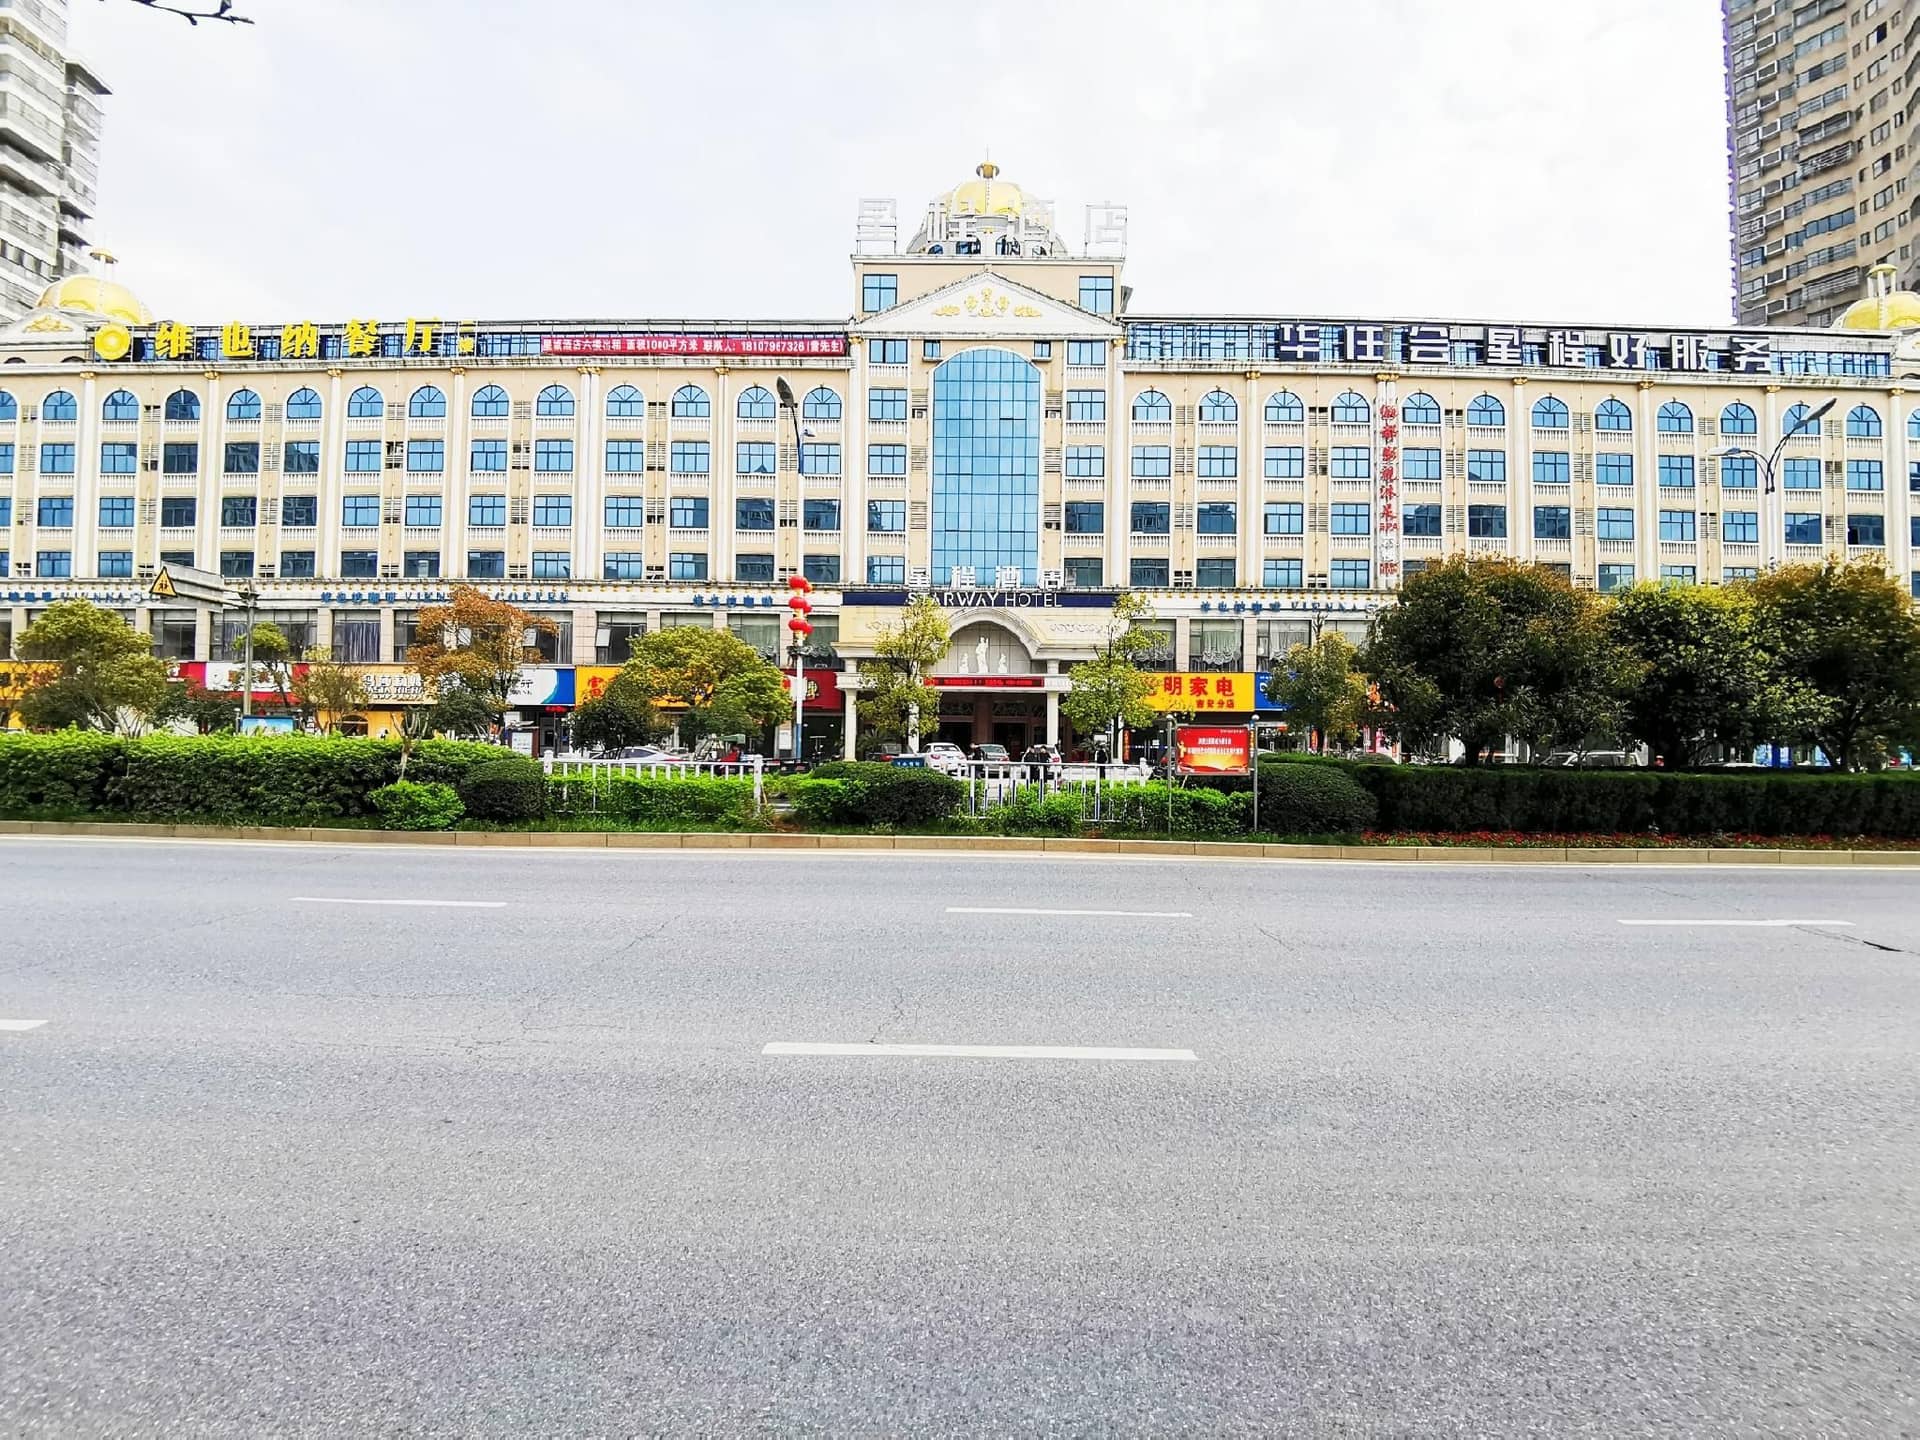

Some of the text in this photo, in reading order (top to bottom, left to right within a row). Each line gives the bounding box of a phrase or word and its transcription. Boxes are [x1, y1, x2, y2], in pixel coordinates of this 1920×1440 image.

[154, 317, 440, 359] 维也纳餐厅
[908, 566, 1064, 589] 星程酒店
[495, 592, 569, 603] COFFEE
[1005, 593, 1062, 607] HOTEL
